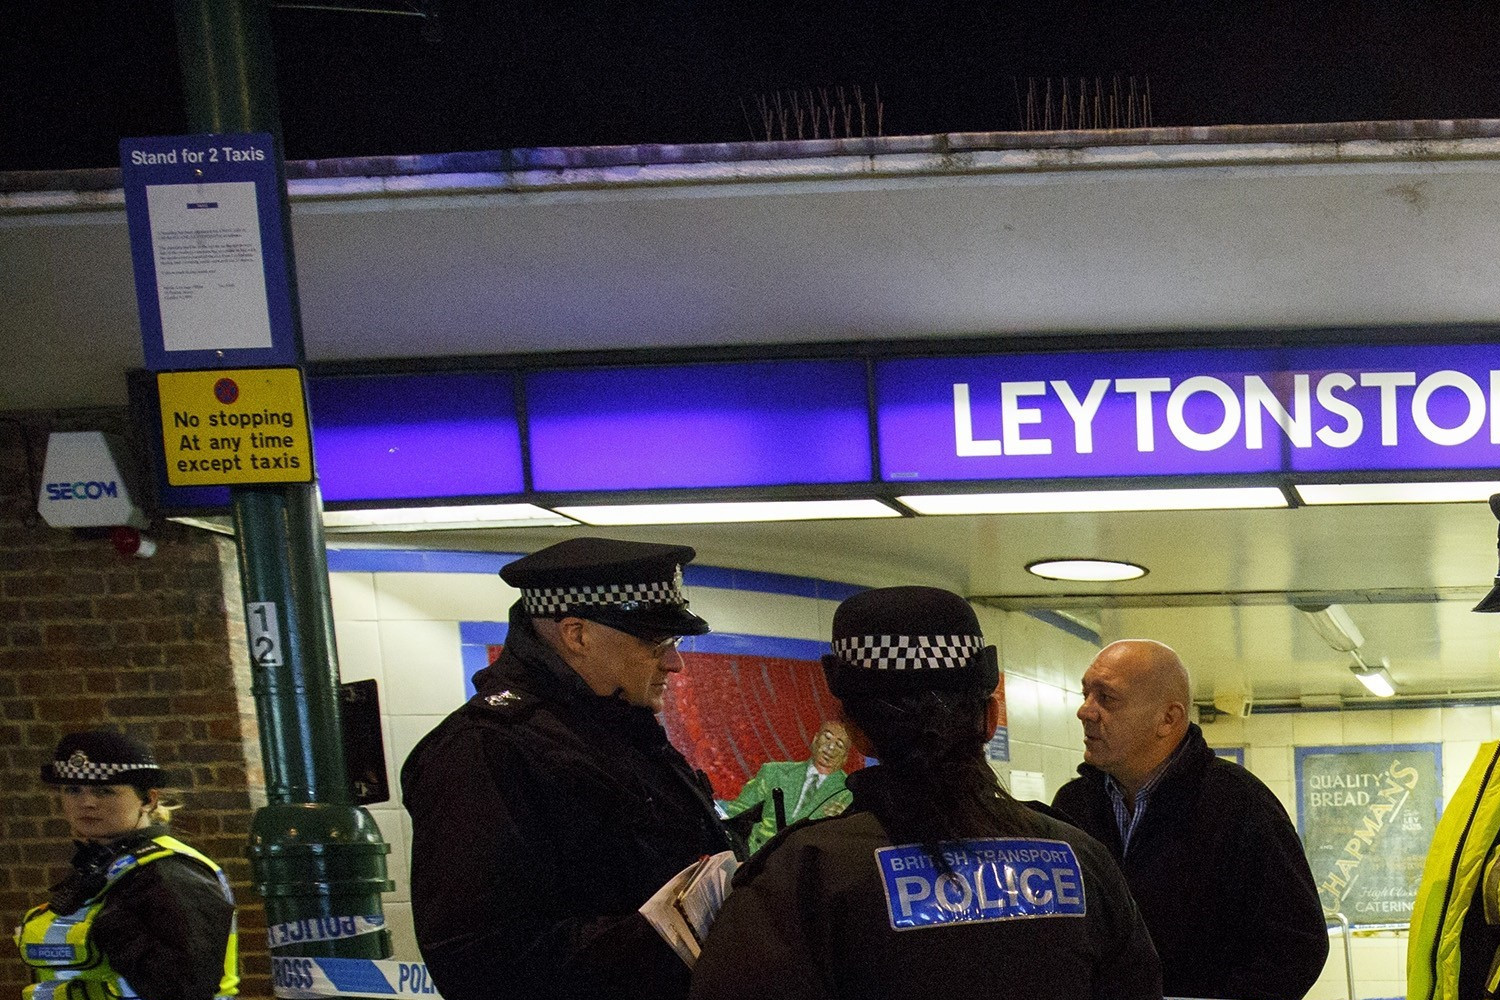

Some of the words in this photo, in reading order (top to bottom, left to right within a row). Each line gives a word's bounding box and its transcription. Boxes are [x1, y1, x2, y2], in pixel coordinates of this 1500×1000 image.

[131, 149, 177, 165] Stand
[181, 149, 204, 163] for
[208, 148, 218, 162] 2
[222, 146, 265, 161] Taxis
[174, 411, 200, 428] No
[208, 409, 293, 430] stopping
[179, 434, 201, 450] At
[209, 435, 241, 453] any
[250, 432, 293, 449] time
[177, 456, 242, 473] except
[251, 453, 300, 469] taxis
[46, 481, 117, 500] SECOM
[1309, 774, 1384, 788] QUALITY
[1310, 791, 1370, 808] BREAD
[890, 851, 968, 872] BRITSH
[895, 867, 1080, 917] POLICE
[273, 959, 314, 989] ROSS
